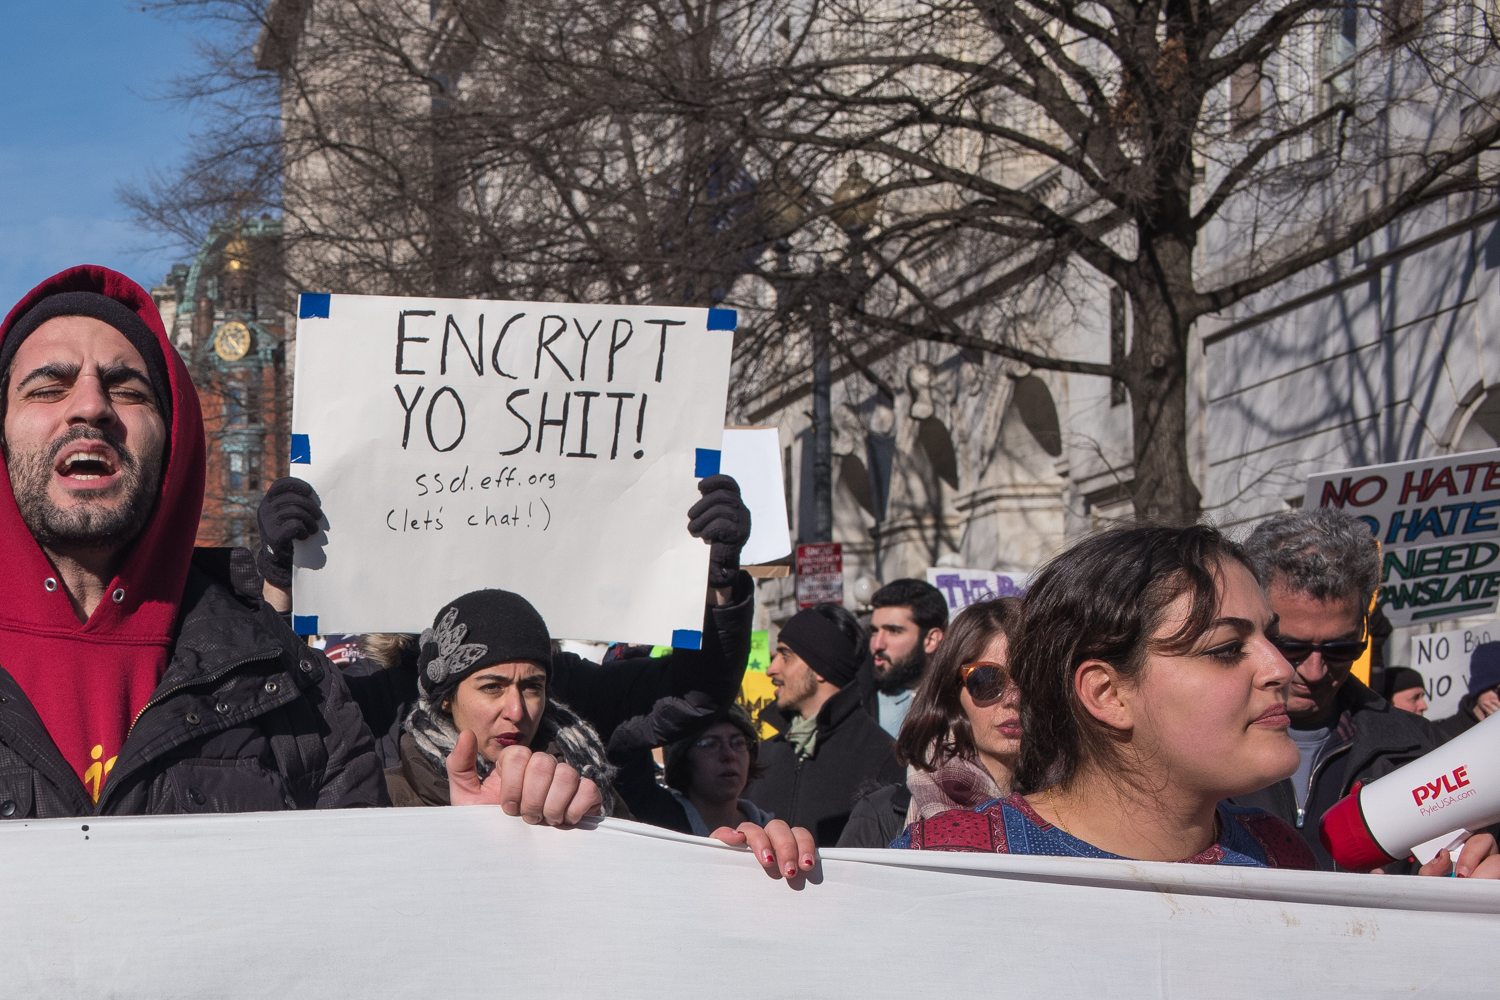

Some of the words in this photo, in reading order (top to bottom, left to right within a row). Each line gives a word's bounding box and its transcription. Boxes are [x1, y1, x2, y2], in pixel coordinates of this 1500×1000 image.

[395, 310, 687, 384] ENCRYPT
[393, 383, 466, 453] YO
[499, 387, 648, 461] SHIT!
[415, 465, 557, 497] ssd.eff.org
[1320, 475, 1388, 509] NO
[467, 497, 552, 532] chat!)
[1384, 499, 1500, 545] HATE
[1381, 541, 1500, 583] NEED
[1417, 636, 1450, 666] NO
[1411, 765, 1471, 807] PYLE
[1419, 787, 1477, 817] PyleUSA.com
